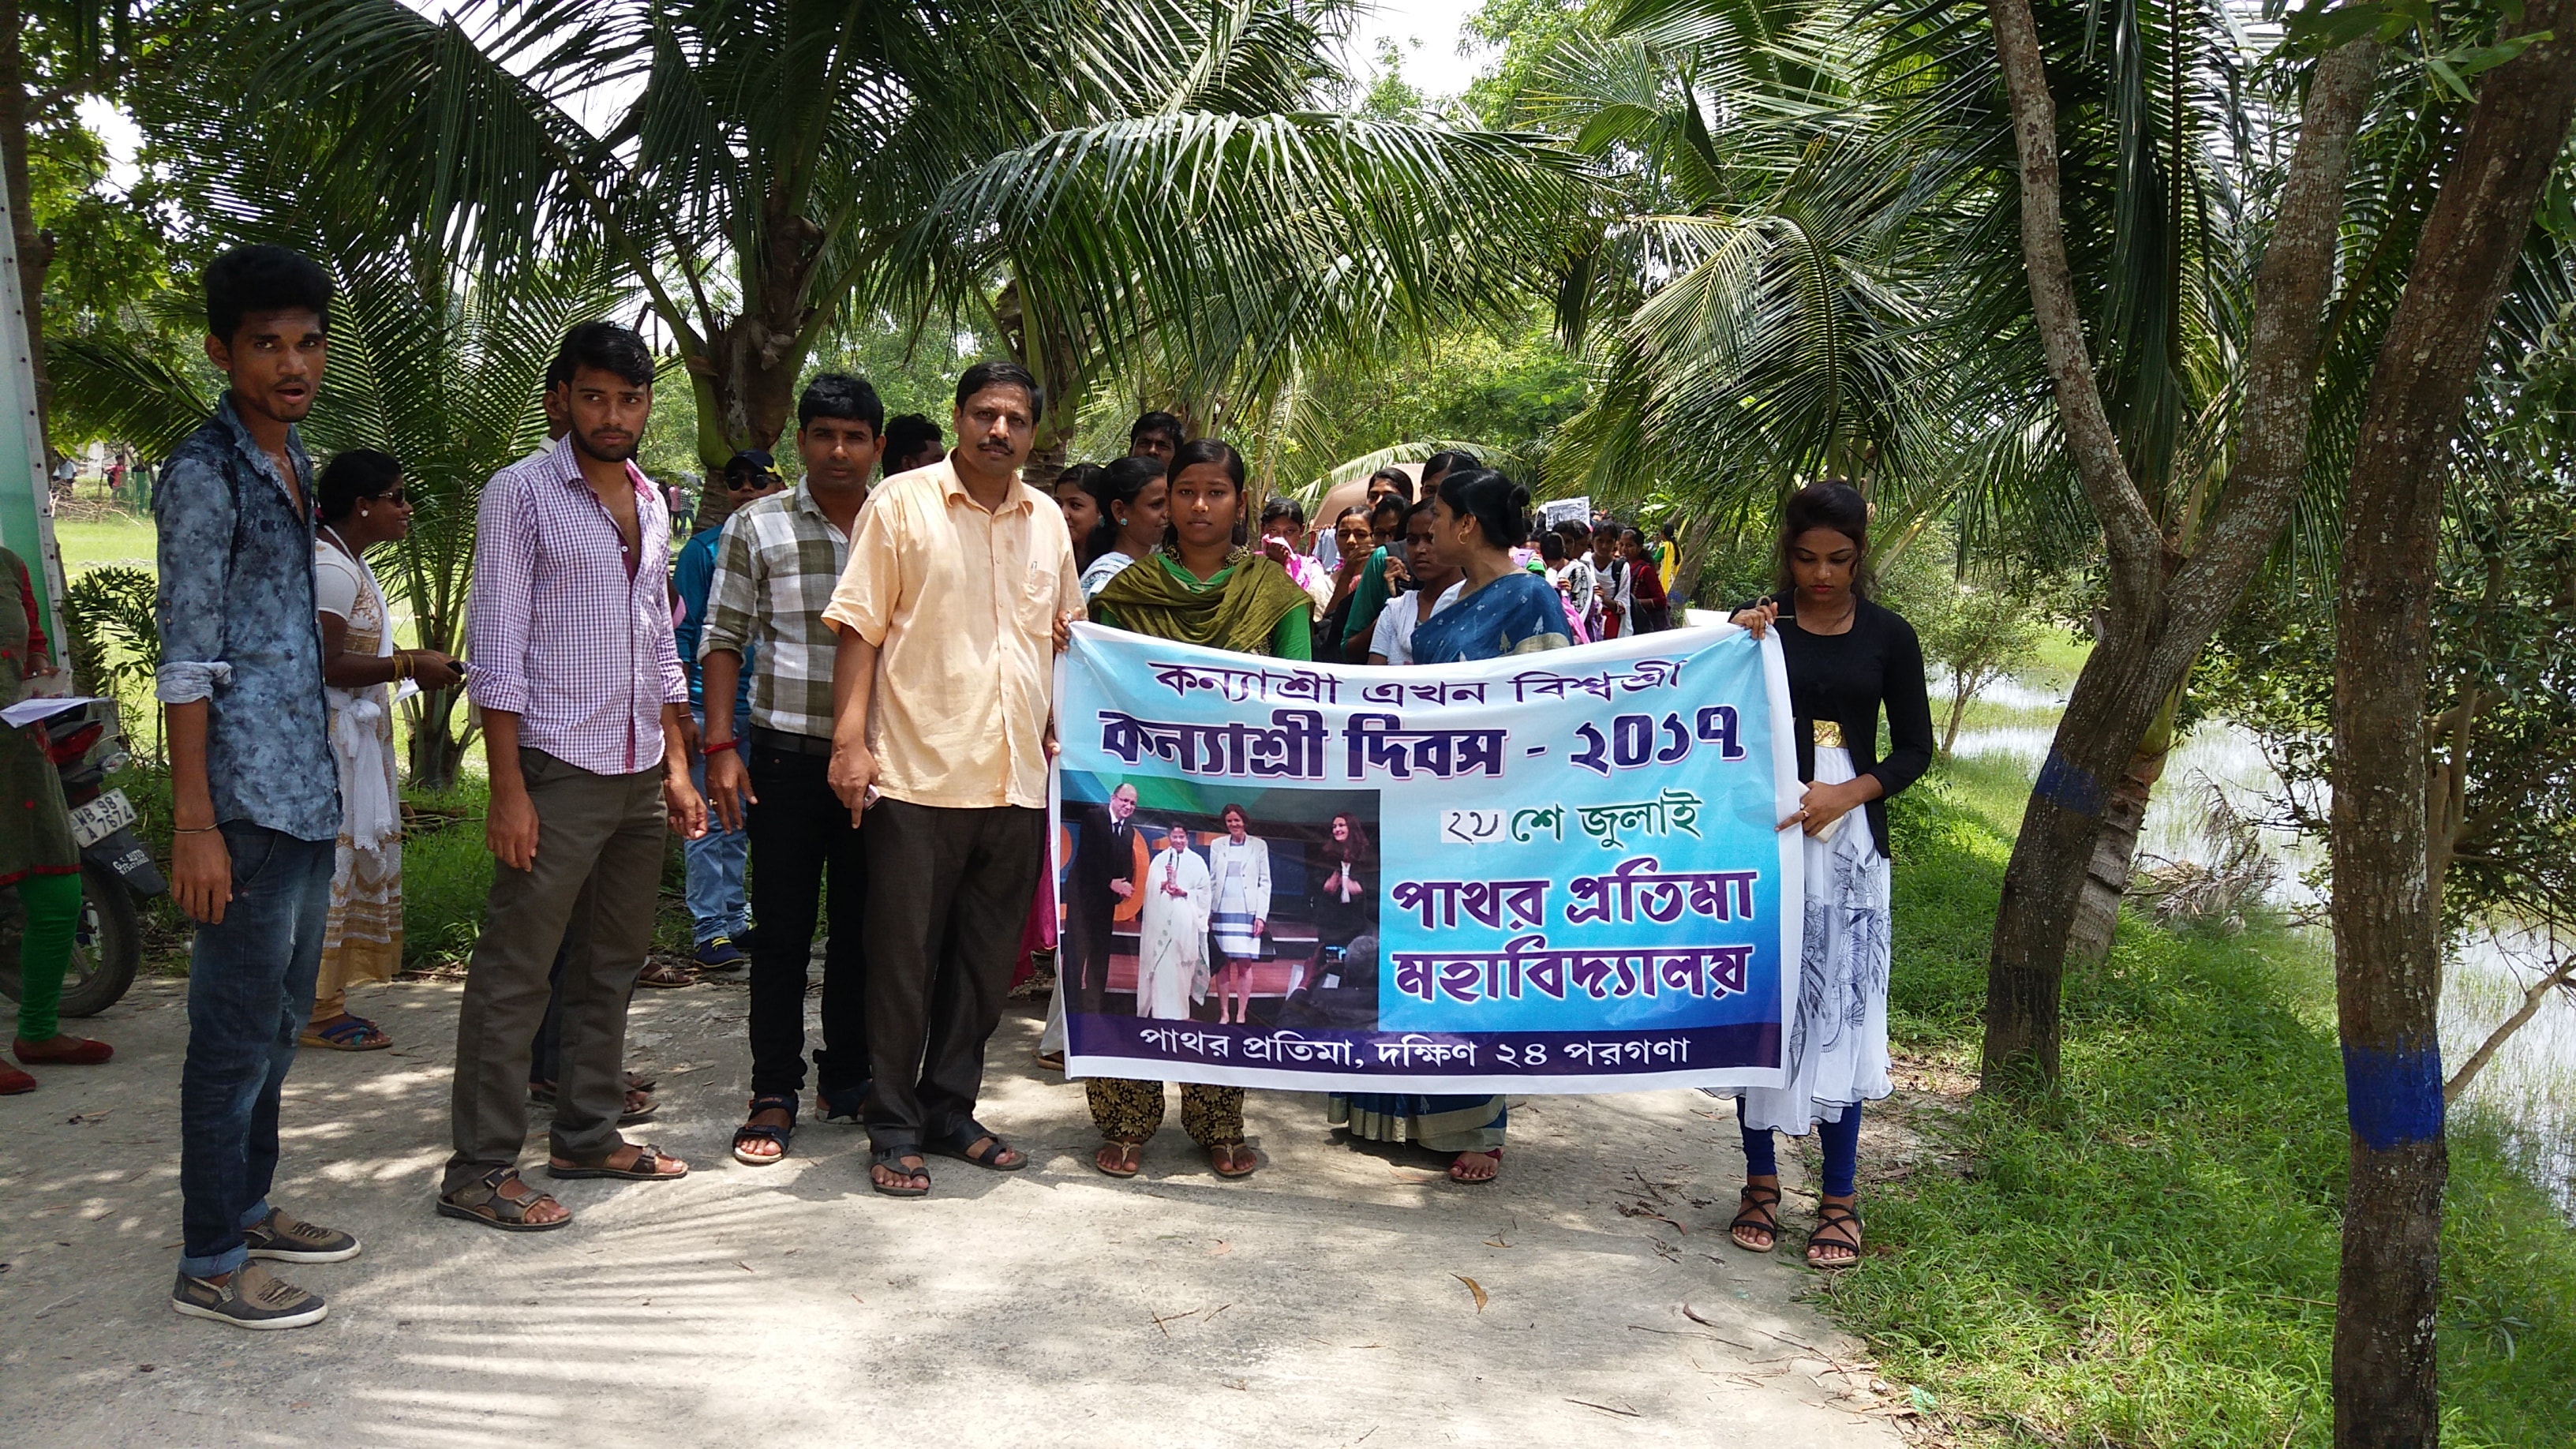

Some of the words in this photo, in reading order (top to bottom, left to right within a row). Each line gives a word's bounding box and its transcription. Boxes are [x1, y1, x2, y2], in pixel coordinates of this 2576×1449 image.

[1147, 663, 1343, 704] কন্যাশ্রী
[1362, 681, 1490, 706] এখন
[1098, 709, 1330, 779] কন্যাশ্রী
[1342, 712, 1507, 779] দিবস
[1570, 706, 1744, 775] ২০১৭
[97, 796, 117, 814] 98
[1576, 788, 1702, 848] জুলাই
[1392, 880, 1550, 930] পাথর
[1566, 856, 1758, 924] প্রতিমা
[1391, 934, 1754, 1002] মহাবিদ্যালয়
[1140, 1028, 1230, 1058] পাথর
[1242, 1030, 1365, 1069] প্রতিমা,
[1375, 1033, 1478, 1068] দক্ষিণ
[1496, 1043, 1548, 1068] ২৪
[1563, 1037, 1692, 1066] পরগণা
